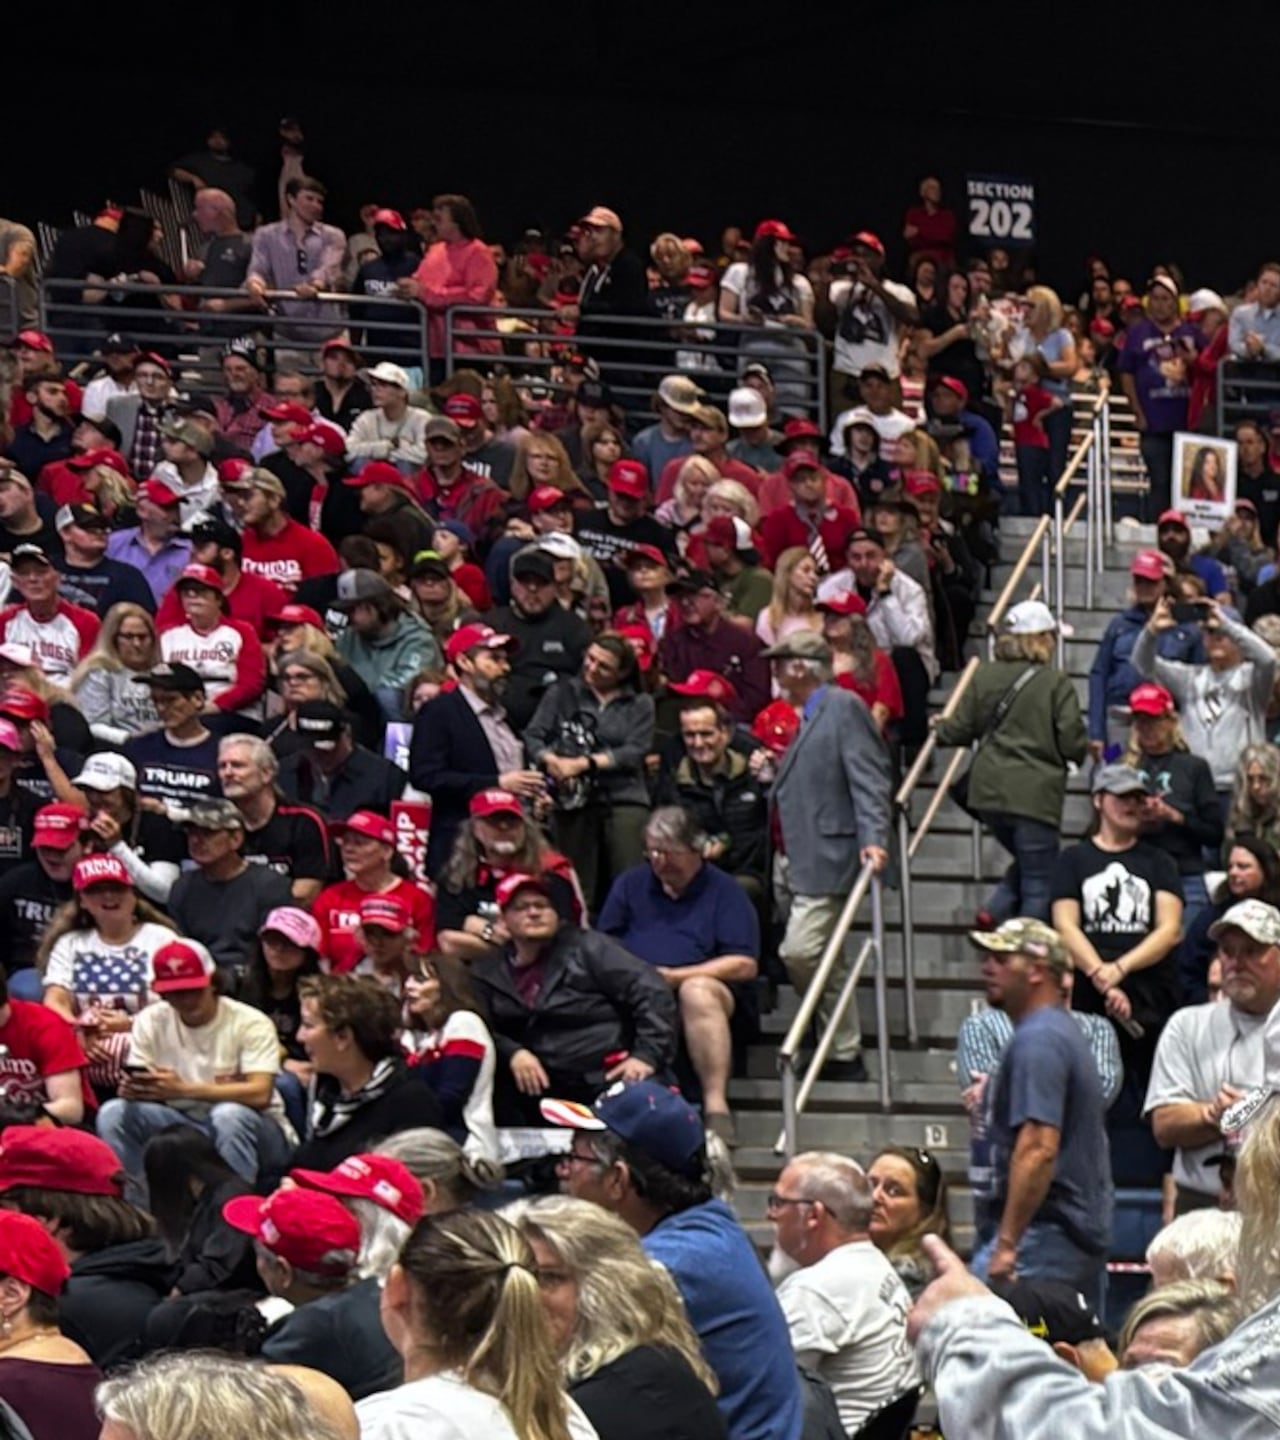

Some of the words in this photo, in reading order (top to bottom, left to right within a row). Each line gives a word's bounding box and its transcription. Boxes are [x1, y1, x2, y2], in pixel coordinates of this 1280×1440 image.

[967, 181, 1034, 201] SECTION
[969, 198, 1033, 239] 202
[144, 767, 211, 788] TRUMP
[77, 859, 122, 880] TRUMP
[14, 899, 56, 921] TRU
